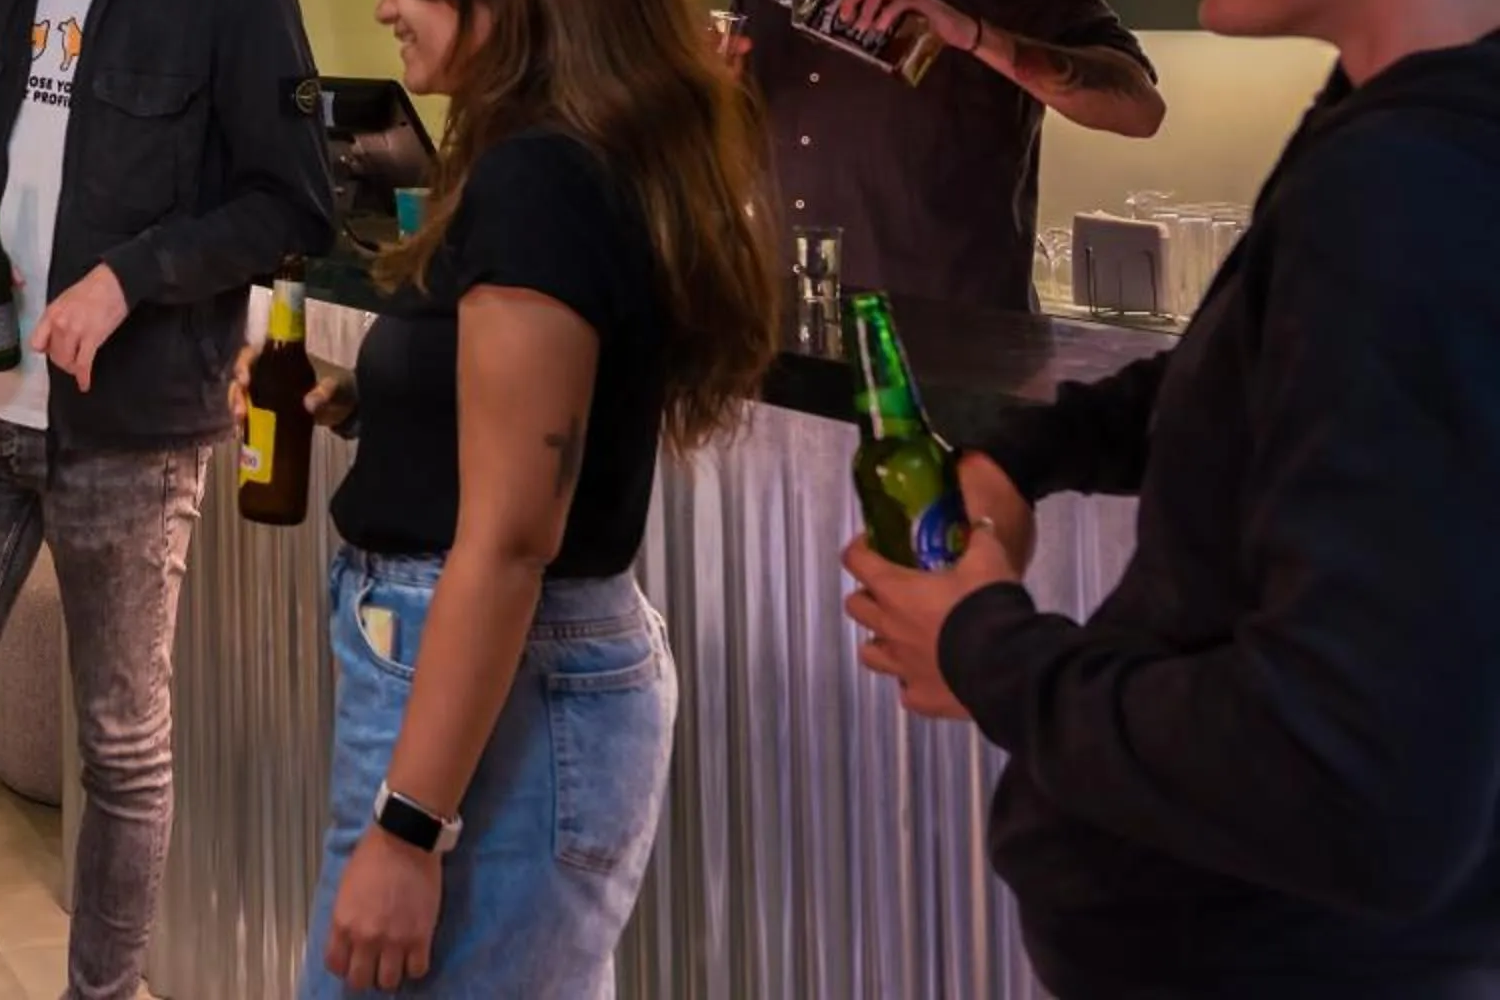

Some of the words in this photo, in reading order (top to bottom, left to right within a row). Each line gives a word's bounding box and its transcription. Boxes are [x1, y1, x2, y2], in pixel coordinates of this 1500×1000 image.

[29, 75, 52, 90] OSE
[57, 79, 73, 93] YO
[33, 90, 68, 107] PROFI
